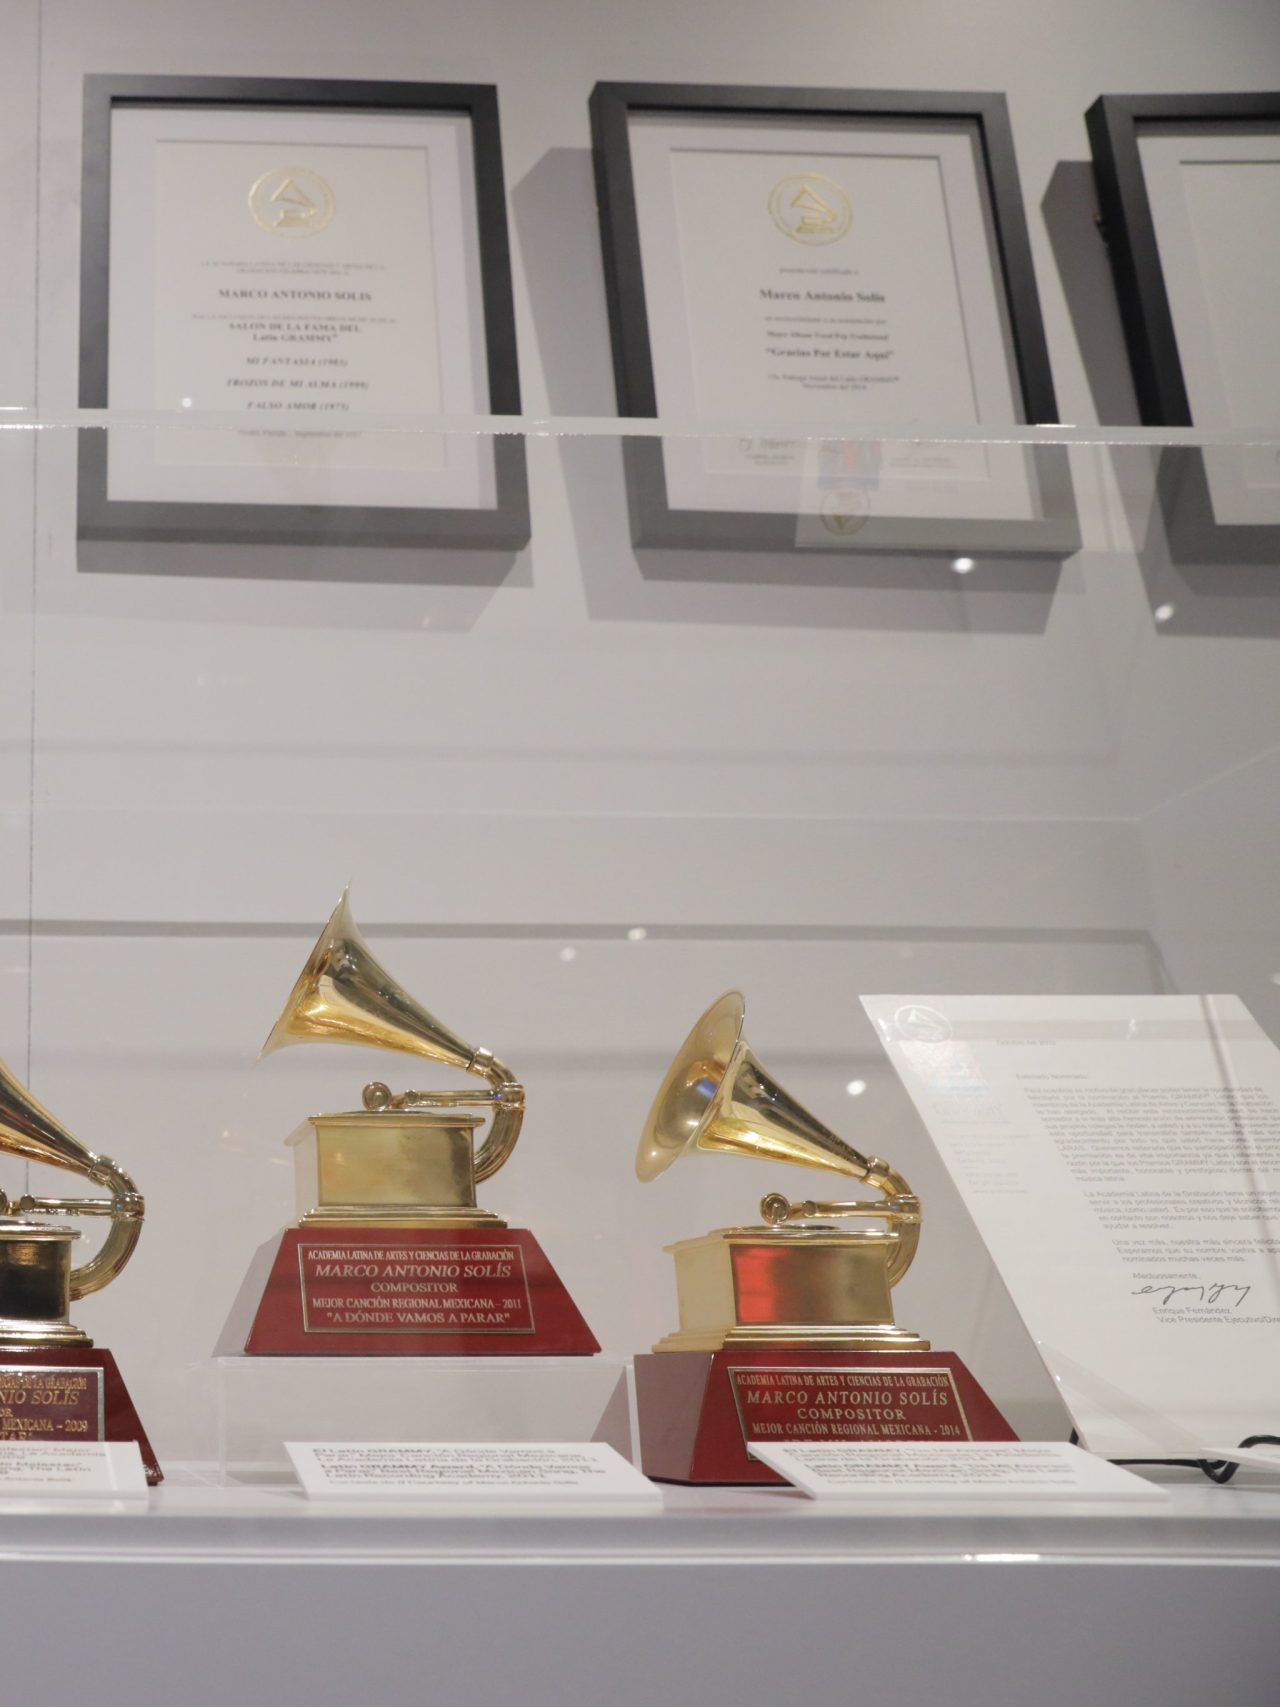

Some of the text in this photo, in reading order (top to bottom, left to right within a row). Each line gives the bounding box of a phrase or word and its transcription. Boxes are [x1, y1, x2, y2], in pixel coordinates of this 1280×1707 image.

[218, 289, 268, 299] MARCO
[272, 289, 332, 300] ANTONIO
[308, 1248, 514, 1261] ACADEMIA LATINA DE ARTES Y CIENCIAS DE LA GRABACIÓN
[315, 1262, 511, 1278] MARCO ANTONIO SOLÍS
[371, 1281, 459, 1293] COMPOSITOR
[313, 1296, 521, 1308] MEJOR CANCIÓN REGIONAL MEXICANA 2011
[327, 1310, 510, 1323] "A DÓNDE VAMOS A PARAR"
[737, 1374, 949, 1388] ACADEMIA LATINA DE ARTES Y CIENCIAS DE LA GRABACIÓN
[31, 1387, 79, 1406] SOLÍS
[747, 1389, 948, 1406] MARCO ANTONIO SOLÍS
[798, 1409, 906, 1420] COMPOSITOR
[3, 1418, 53, 1431] MEXICANA
[65, 1420, 88, 1432] 2009
[753, 1421, 960, 1436] MEJOR CANCIÓN REGIONAL MEXICANA 2014
